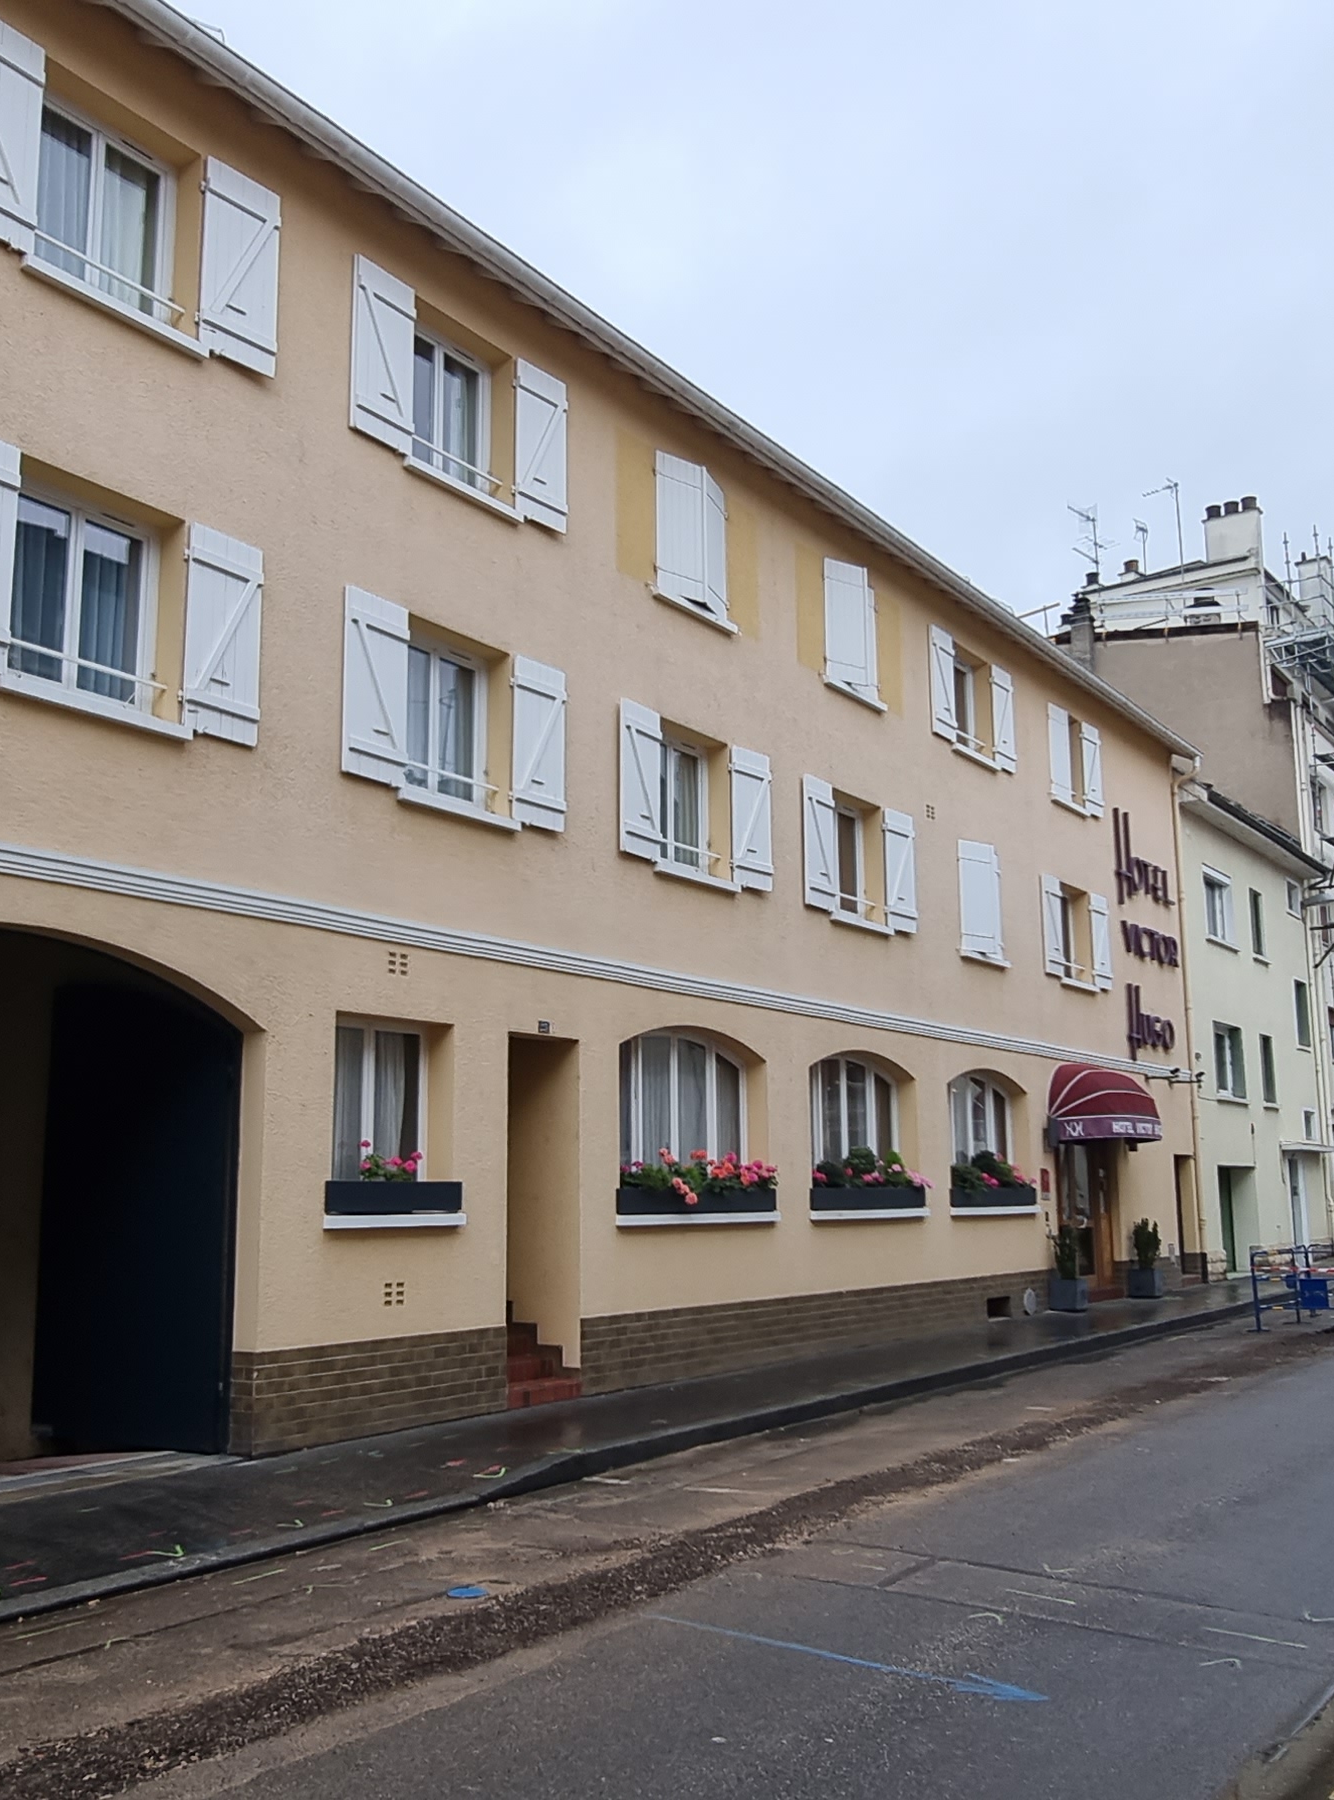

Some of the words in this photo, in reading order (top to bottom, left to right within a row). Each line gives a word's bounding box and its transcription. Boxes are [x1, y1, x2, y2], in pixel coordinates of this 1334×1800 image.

[1112, 807, 1175, 906] HOTEL
[1120, 920, 1180, 968] VICTOR
[1125, 983, 1175, 1061] HUGO
